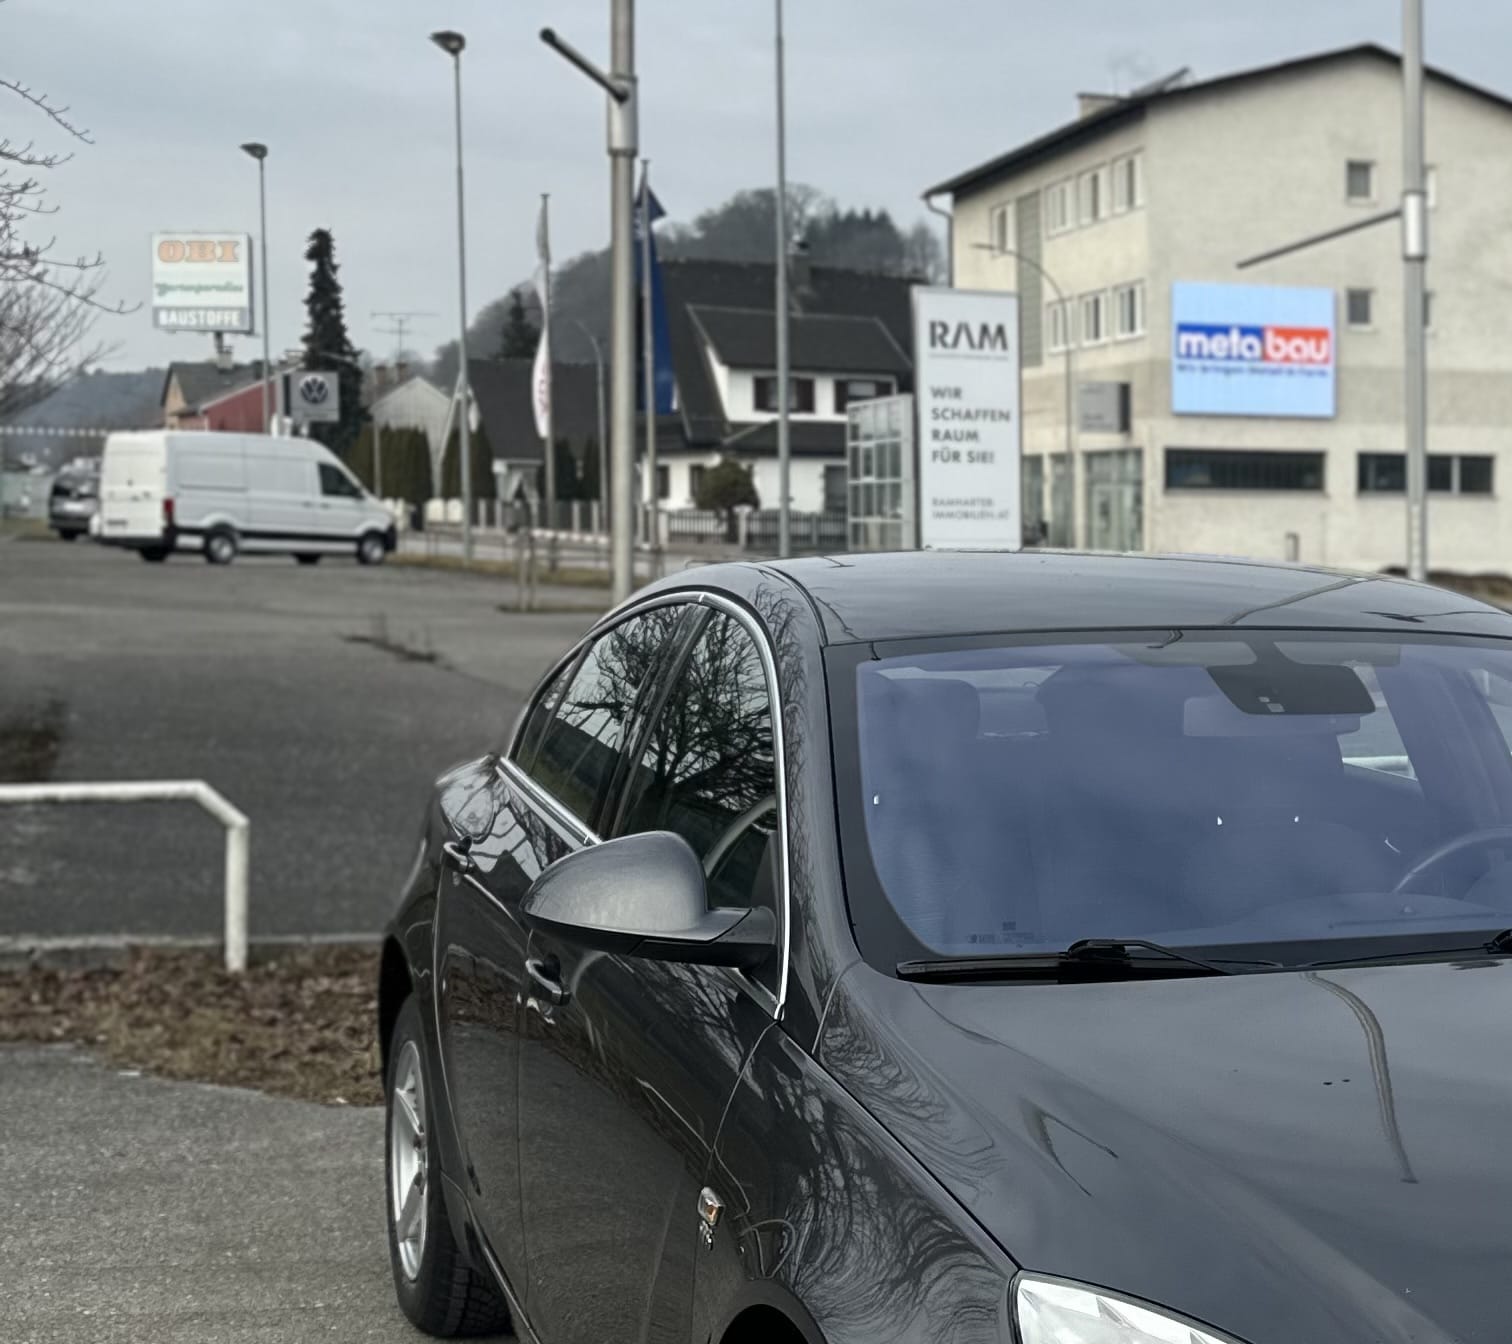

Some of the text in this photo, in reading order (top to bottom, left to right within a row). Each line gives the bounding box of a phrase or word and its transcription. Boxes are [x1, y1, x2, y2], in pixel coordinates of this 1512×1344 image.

[158, 240, 239, 263] OBI
[159, 309, 240, 326] BAUSTOFFE
[929, 321, 1008, 351] RAM
[930, 386, 962, 400] WIR
[931, 407, 1011, 423] SCHAFFEN
[932, 429, 979, 442] RAUM
[932, 447, 995, 464] FÜR SIE!
